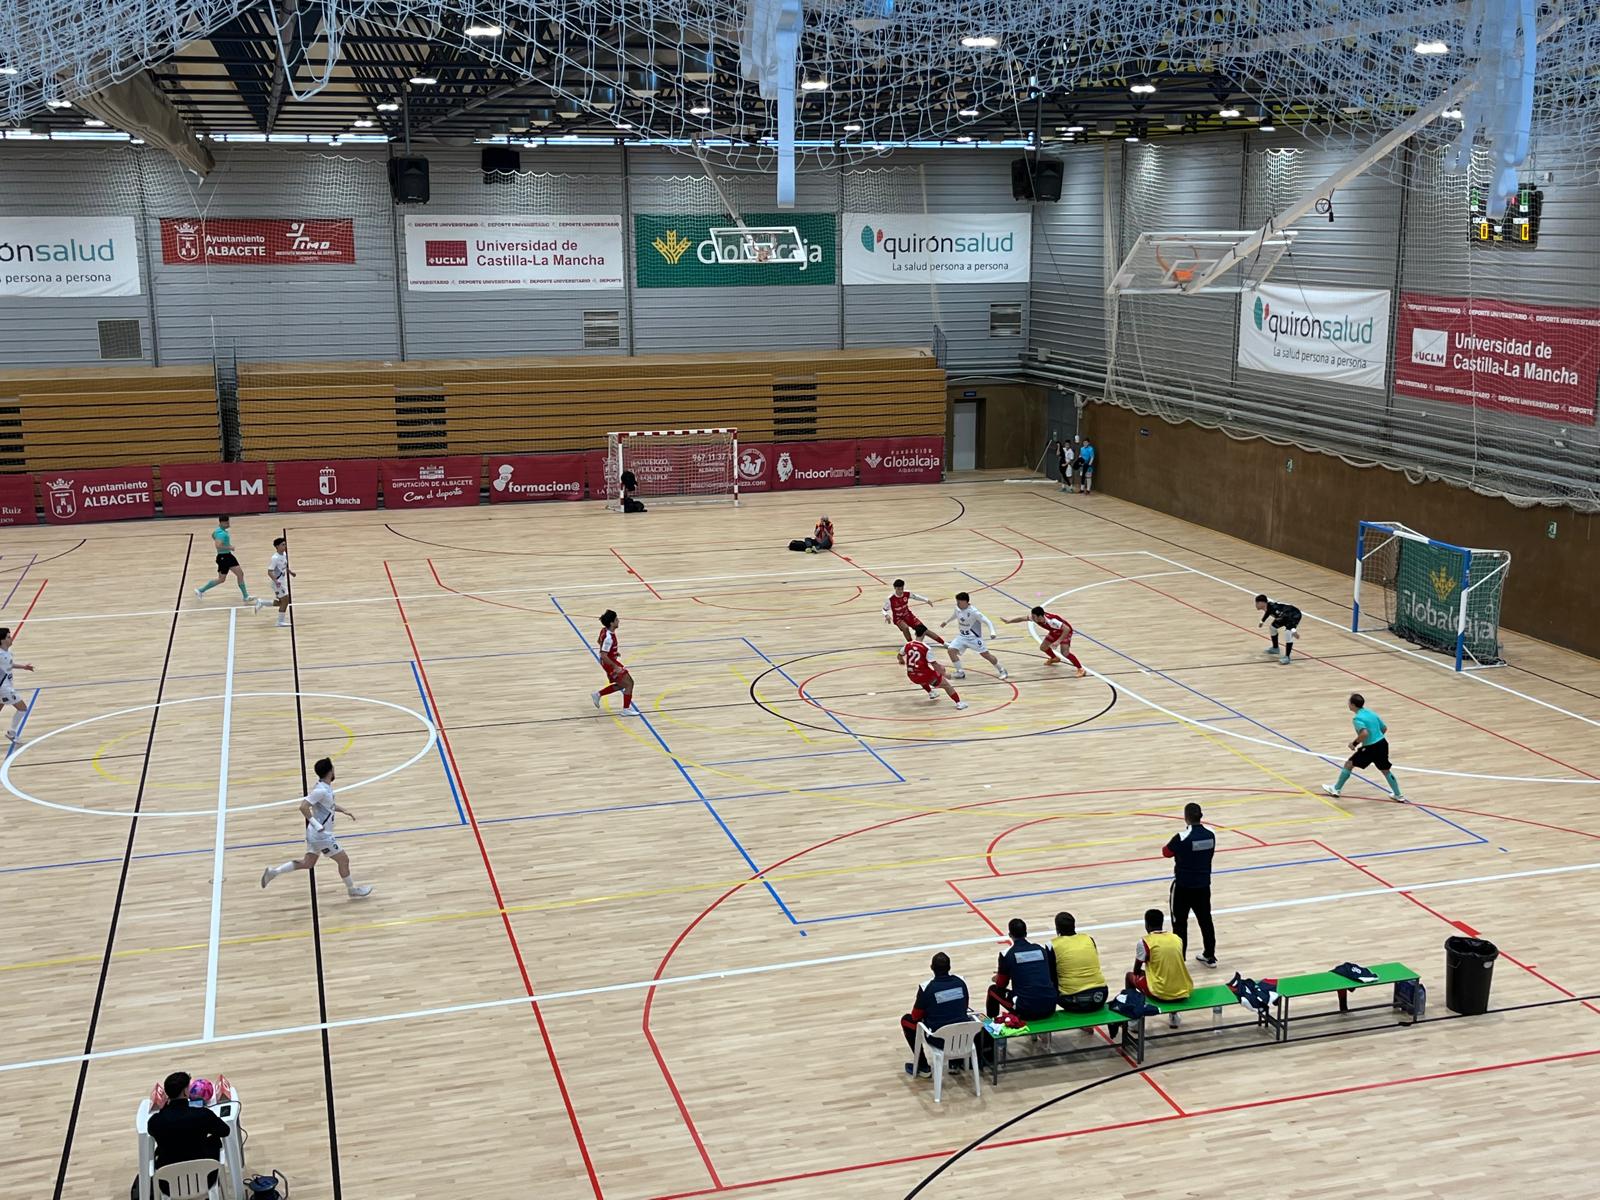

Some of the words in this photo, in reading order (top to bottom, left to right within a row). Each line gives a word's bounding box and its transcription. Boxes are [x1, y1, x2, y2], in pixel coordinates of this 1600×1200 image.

[205, 235, 265, 244] Ayuntamiento
[476, 240, 558, 252] Universidad
[561, 240, 578, 251] de
[883, 232, 1014, 260] quirónsalud
[206, 246, 266, 256] ALBACETE
[436, 257, 466, 265] UCLM
[553, 254, 605, 265] Mancha
[892, 262, 902, 271] La
[904, 262, 927, 271] salud
[929, 264, 964, 272] persona
[974, 263, 1009, 272] persona
[5, 275, 52, 283] persona
[65, 273, 112, 284] persona
[1535, 315, 1560, 323] DEPORTE
[1268, 311, 1373, 344] quirónsalud
[1455, 332, 1532, 356] Universidad
[1535, 342, 1552, 359] de
[1273, 346, 1281, 357] La
[1282, 349, 1300, 360] salud
[1301, 352, 1328, 364] persona
[1336, 357, 1367, 368] persona
[1418, 351, 1444, 364] UCLM
[1524, 363, 1578, 385] Mancha
[1568, 405, 1593, 415] DEPORTE
[883, 454, 940, 470] Globalcaja
[795, 466, 855, 479] indoorland
[82, 481, 148, 495] Ayuntamiento
[185, 479, 264, 497] UCLM
[392, 480, 430, 488] DIPUTACIÓN
[441, 479, 473, 487] ALBACETE
[83, 492, 150, 508] ALBACETE
[403, 491, 424, 502] Con
[426, 489, 433, 499] el
[436, 486, 463, 501] deporte
[335, 497, 361, 505] Mancha
[2, 506, 21, 514] Ruiz
[908, 649, 921, 668] 22
